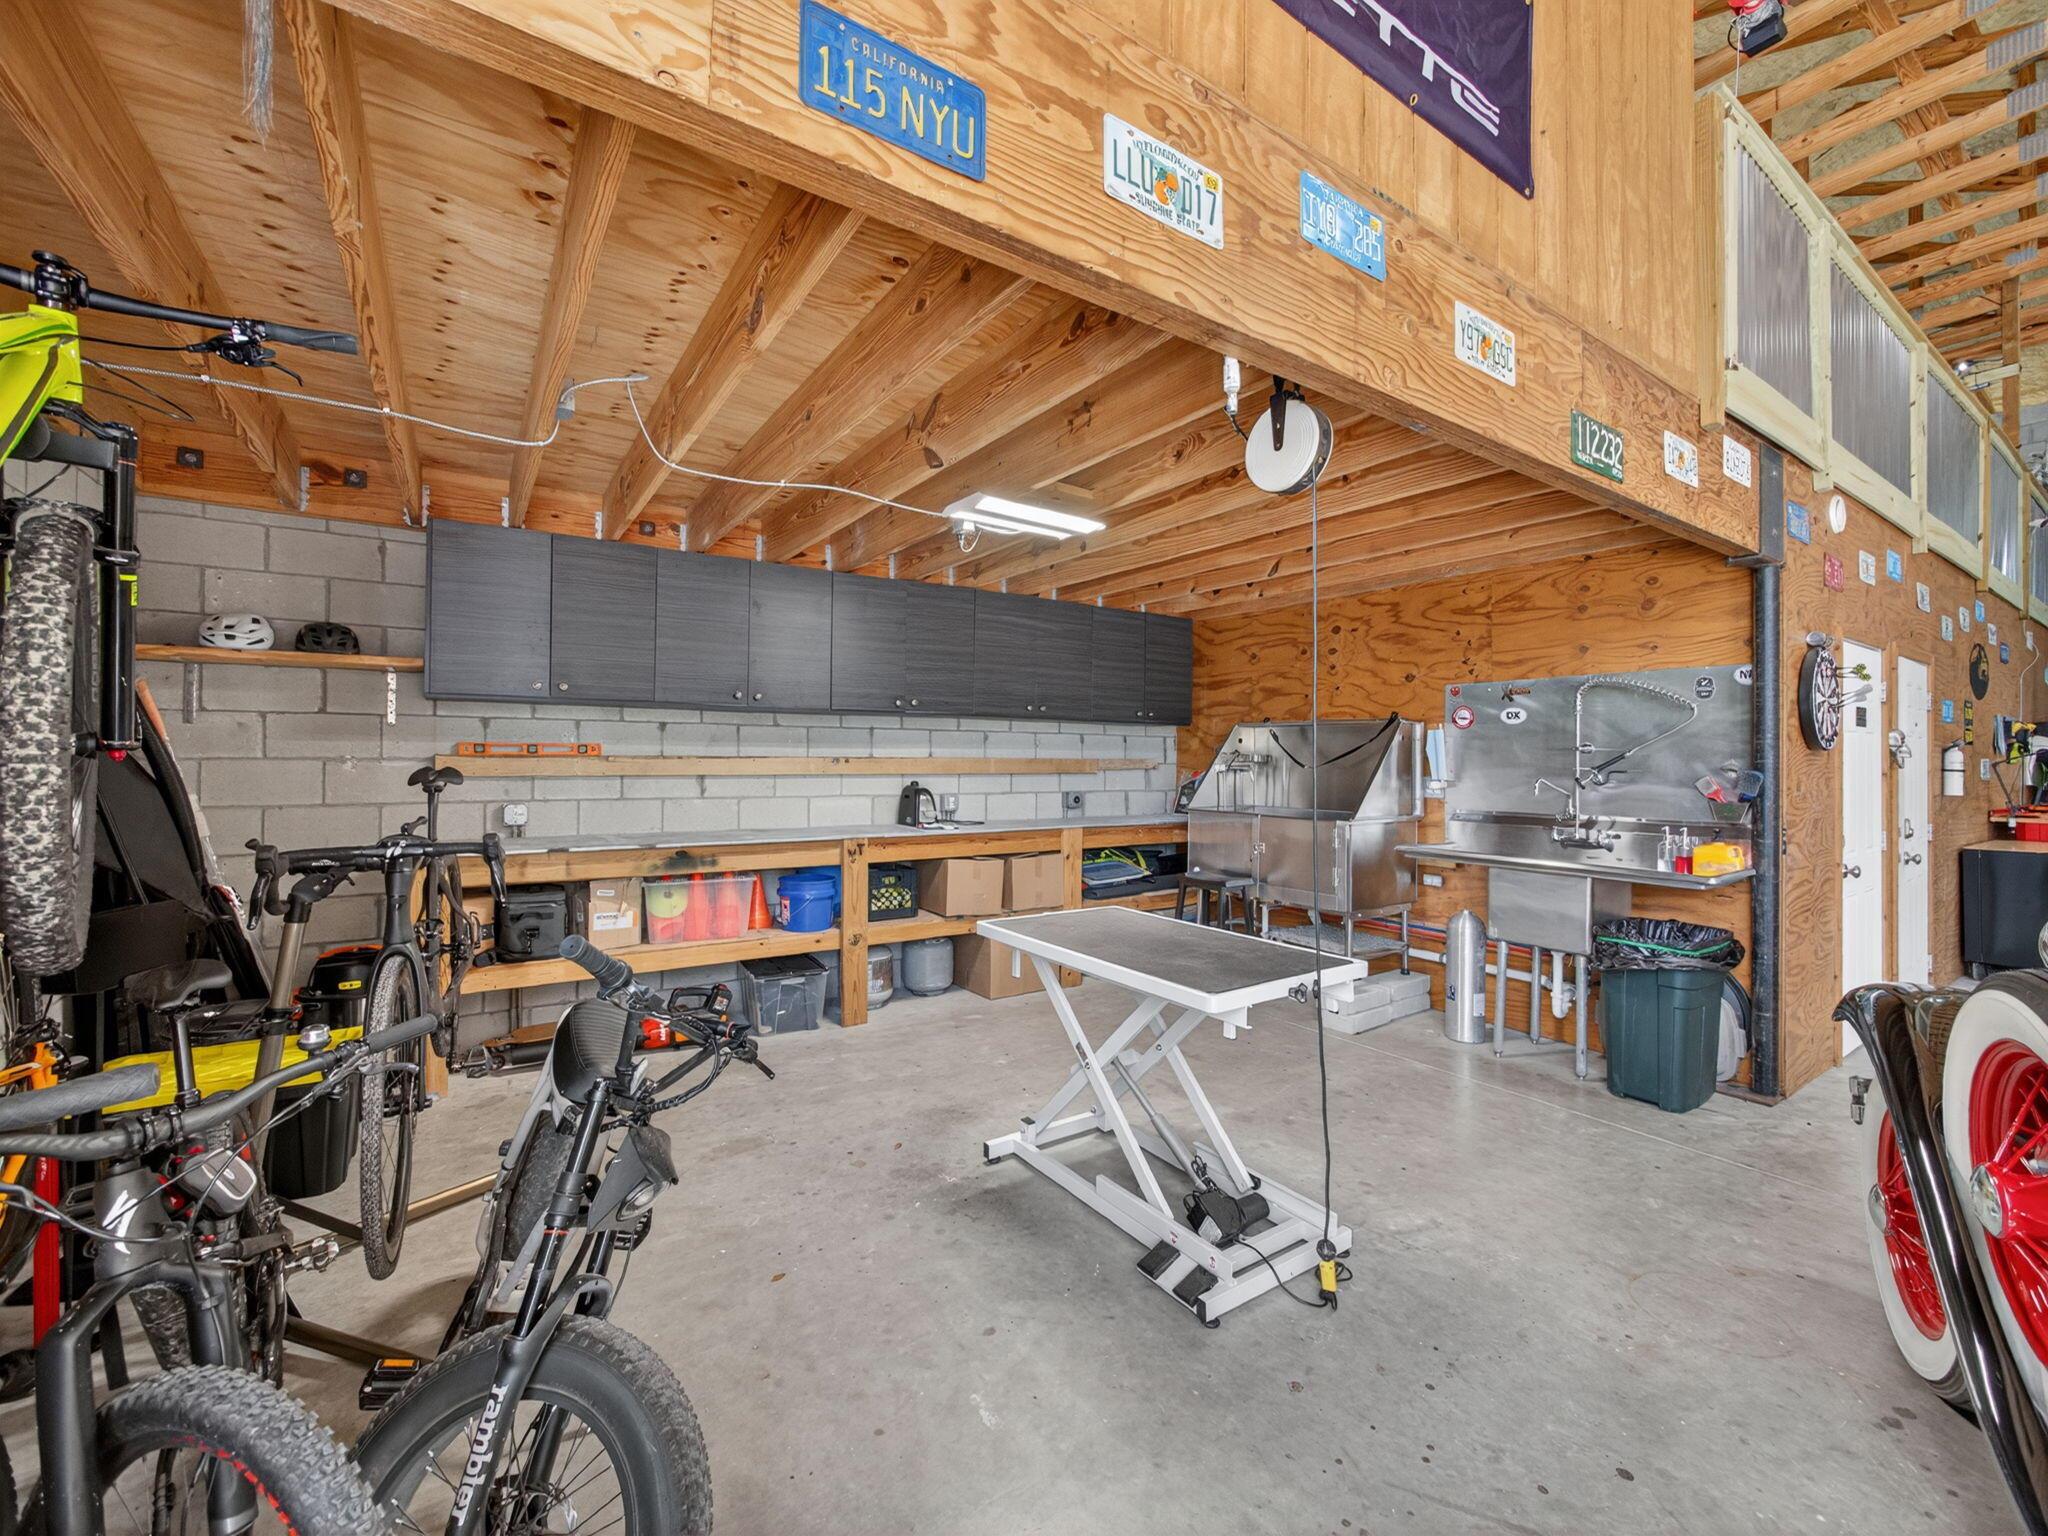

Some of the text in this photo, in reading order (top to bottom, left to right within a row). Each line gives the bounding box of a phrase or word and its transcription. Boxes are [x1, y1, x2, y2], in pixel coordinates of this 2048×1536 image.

[813, 45, 975, 159] 115 NYU
[851, 37, 944, 95] CALIFORNIA
[1506, 711, 1521, 720] DX
[452, 1383, 509, 1527] rambler
